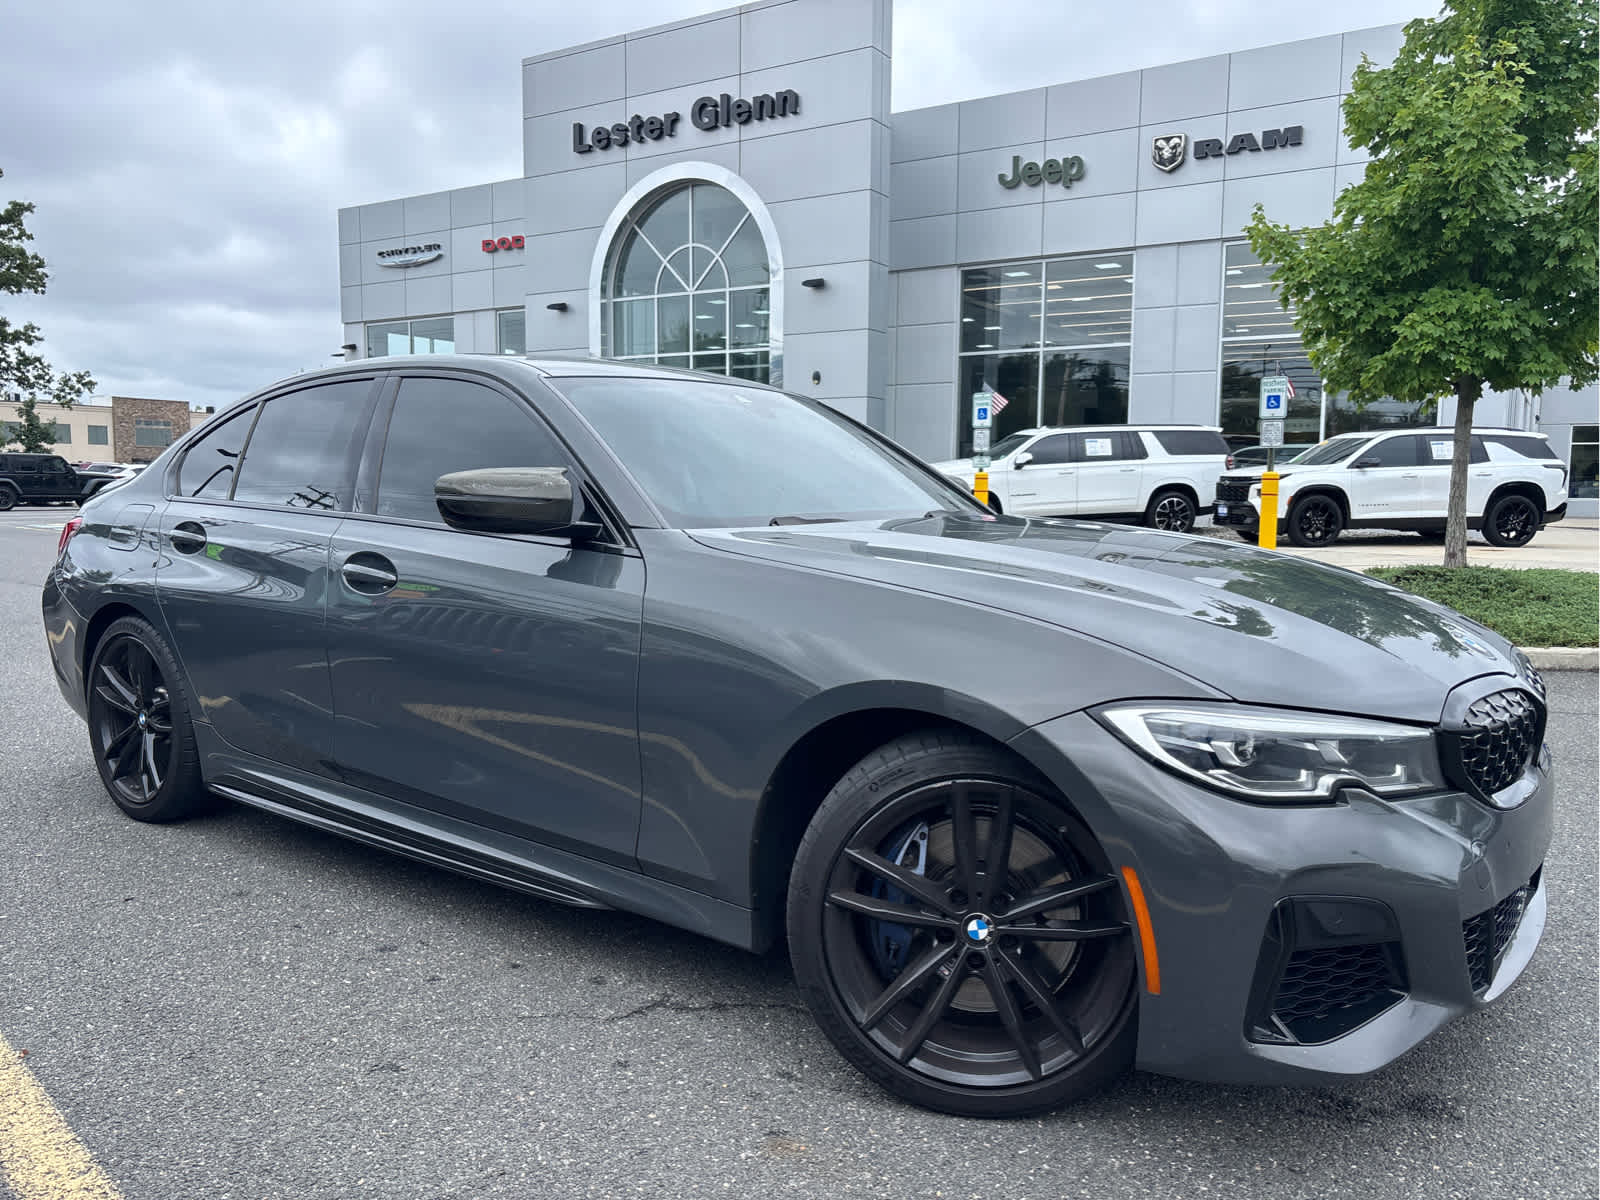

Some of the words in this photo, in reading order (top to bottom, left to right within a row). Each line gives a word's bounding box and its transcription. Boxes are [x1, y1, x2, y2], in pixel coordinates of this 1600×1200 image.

[573, 111, 681, 154] Lester
[691, 89, 800, 132] Glenn
[1193, 125, 1304, 160] RAM
[998, 155, 1085, 189] Jeep
